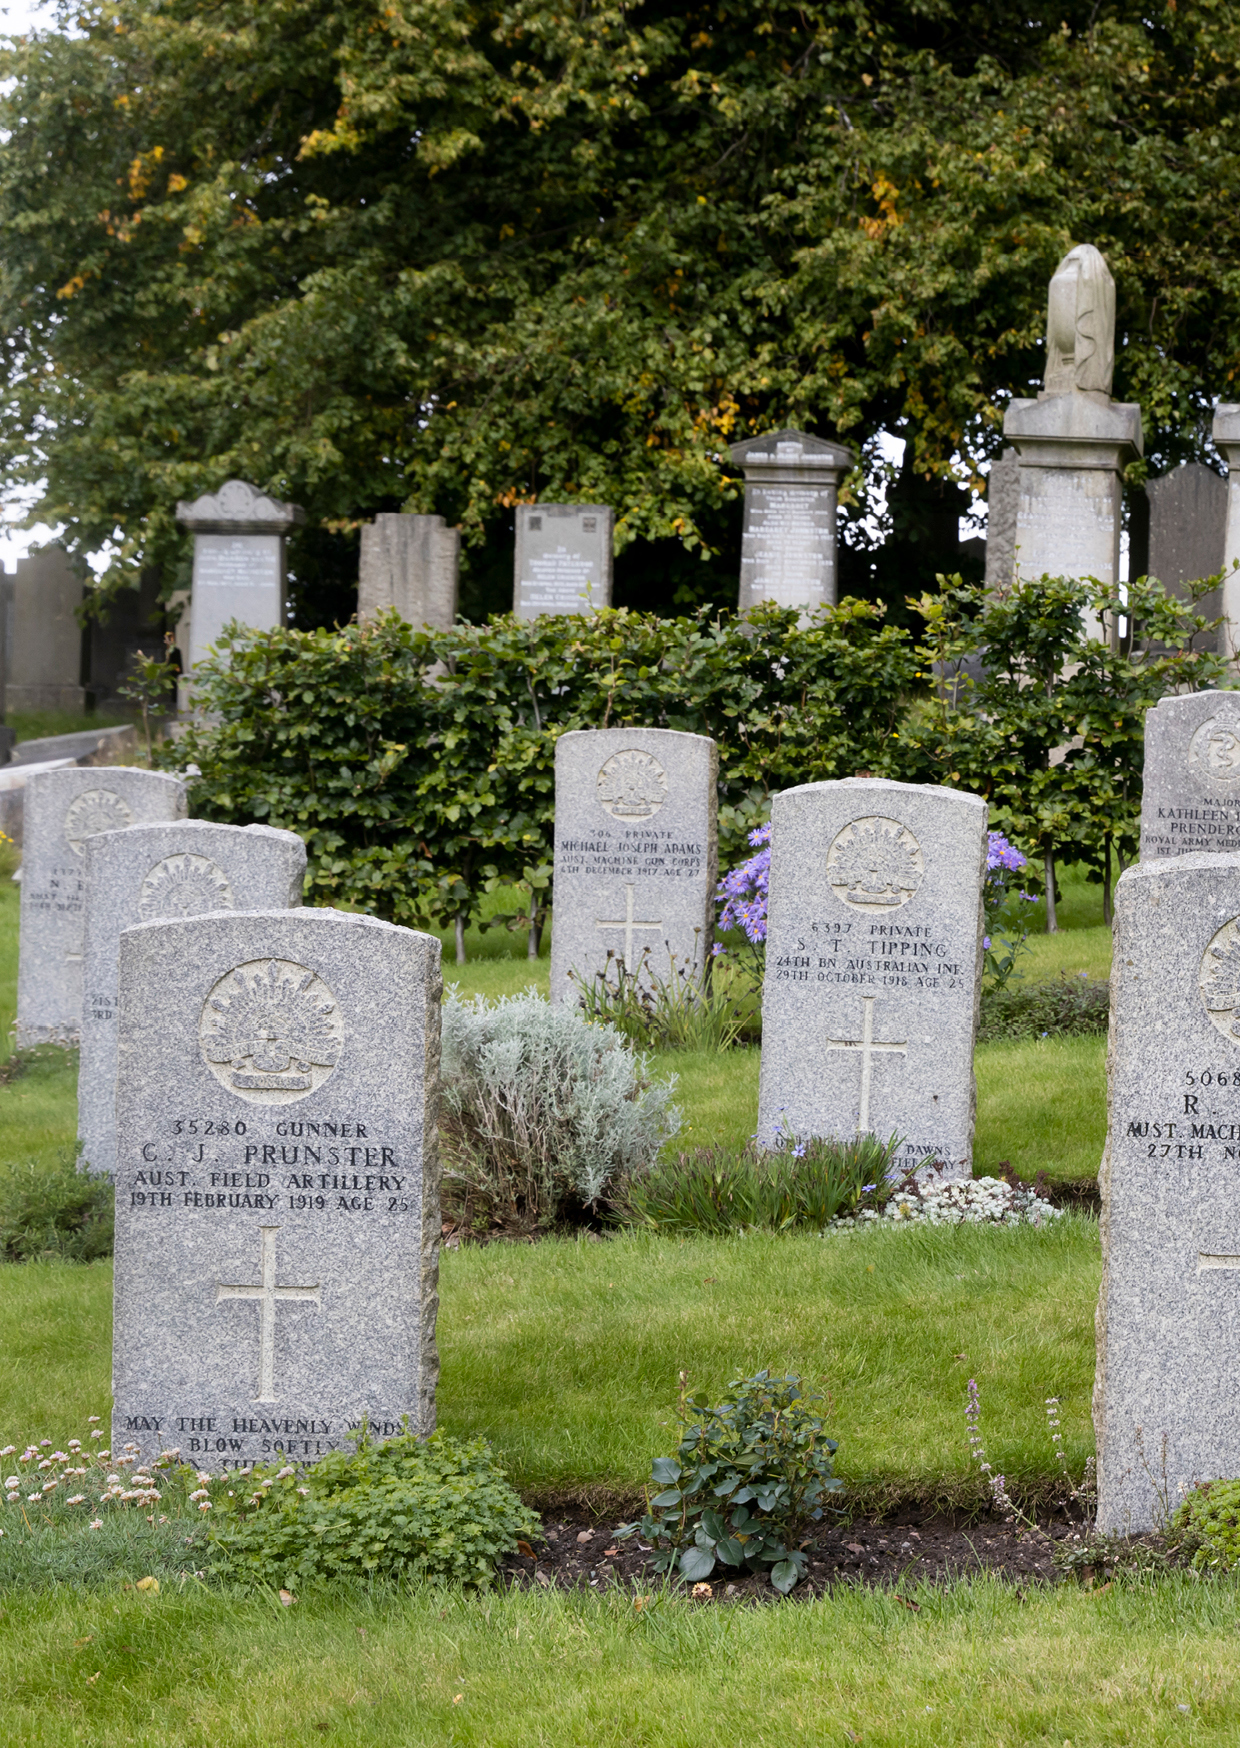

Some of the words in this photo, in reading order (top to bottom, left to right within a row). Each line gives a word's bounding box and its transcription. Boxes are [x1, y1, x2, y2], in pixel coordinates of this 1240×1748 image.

[1203, 799, 1240, 807] MAJOR
[1158, 808, 1228, 820] KATHLEEN
[626, 831, 674, 839] PRIVATE
[1145, 835, 1175, 844] ROYAL
[1182, 837, 1211, 847] ARMY
[561, 841, 608, 852] MICHAEL
[618, 842, 658, 854] JOSEPH
[664, 844, 701, 855] ADAMS
[594, 856, 638, 865] MACHINE
[645, 857, 665, 865] GUN
[672, 857, 700, 867] CORPS
[585, 867, 633, 875] DECEMBER
[637, 868, 658, 876] 1917
[663, 868, 681, 876] AGE
[870, 925, 932, 937] PRIVATE
[868, 940, 947, 957] TIPPING
[776, 956, 810, 967] 24TH
[847, 959, 928, 973] AUSTRALIAN
[776, 970, 808, 981] 29TH
[818, 972, 875, 984] OCTOBER
[883, 975, 908, 986] 1918
[915, 977, 938, 987] AGE
[950, 978, 964, 989] 25
[171, 1120, 247, 1136] 35280
[276, 1122, 368, 1138] GUNNER
[1127, 1122, 1183, 1140] AUST.
[244, 1145, 399, 1167] PRUNSTER
[906, 1145, 951, 1155] DAWNS
[1148, 1144, 1203, 1159] 27TH
[134, 1171, 196, 1187] AUST.
[211, 1172, 270, 1188] FIELD
[287, 1173, 406, 1191] ARTILLERY
[130, 1191, 172, 1207] 19TH
[183, 1192, 279, 1209] FEBRUARY
[289, 1195, 325, 1210] 1919
[336, 1196, 374, 1211] AGE
[387, 1197, 408, 1212] 25
[126, 1416, 164, 1431] MAY
[176, 1417, 218, 1432] THE
[232, 1418, 333, 1434] HEAVENLY
[343, 1419, 405, 1436] WNDS
[189, 1438, 244, 1452] BLOW
[262, 1439, 340, 1455] SOFTLY
